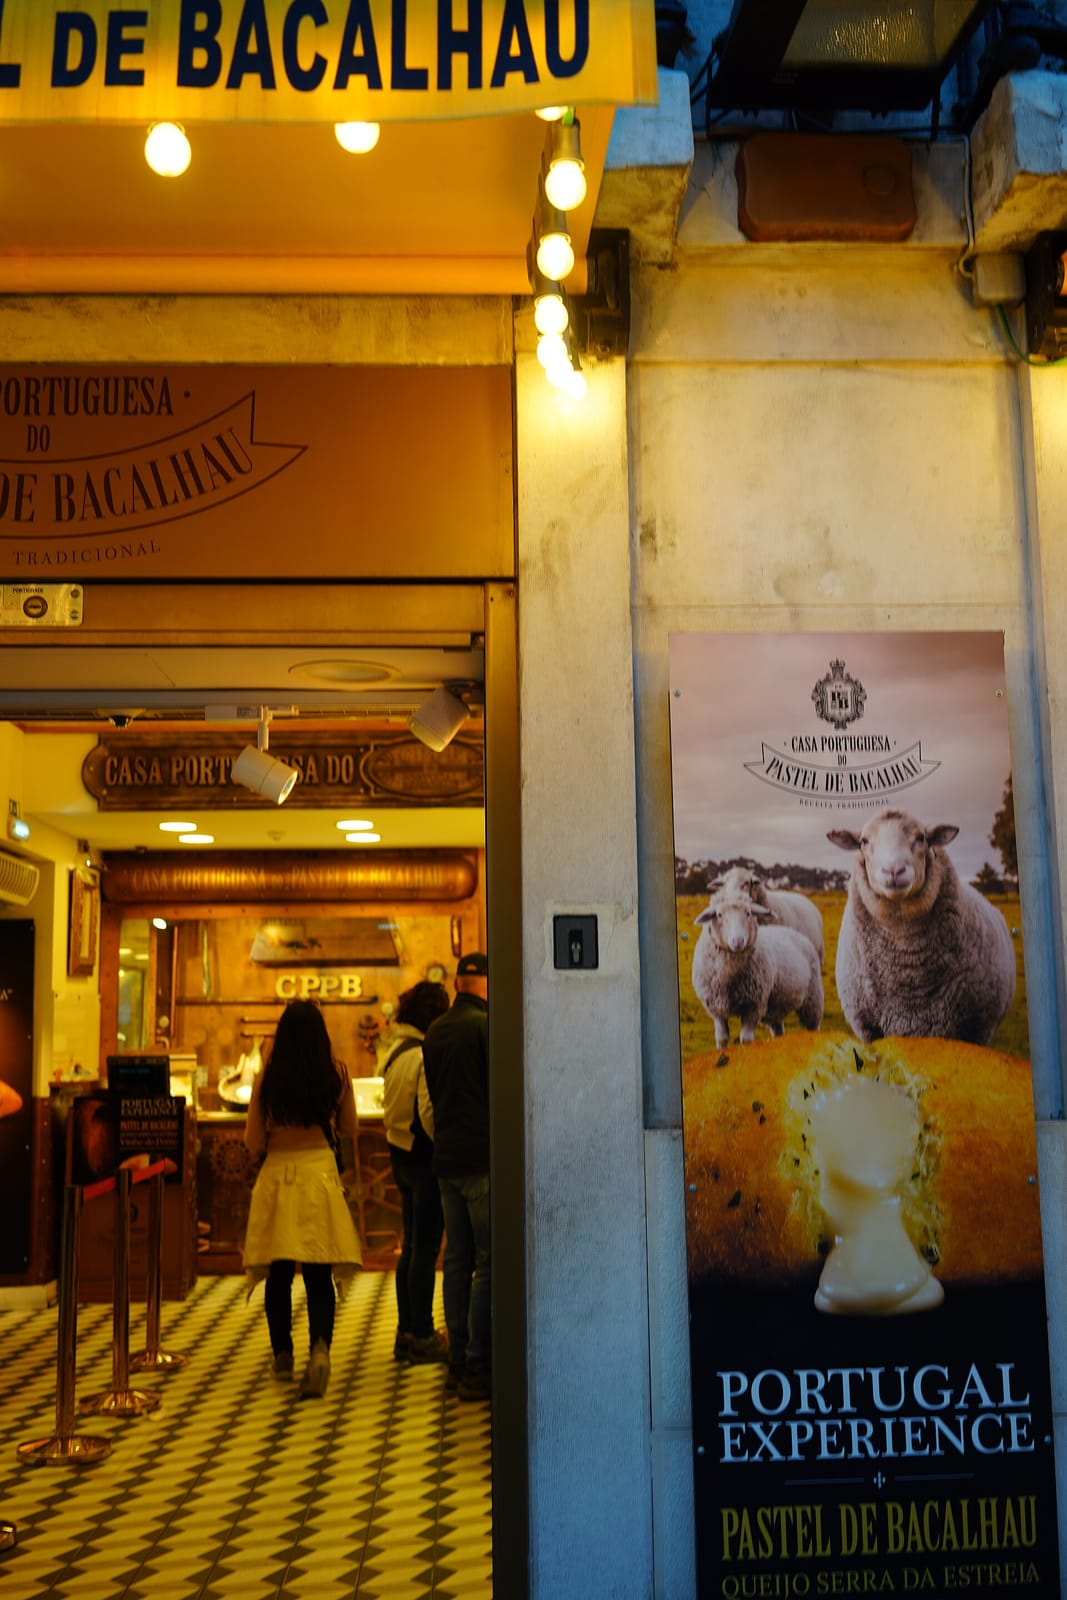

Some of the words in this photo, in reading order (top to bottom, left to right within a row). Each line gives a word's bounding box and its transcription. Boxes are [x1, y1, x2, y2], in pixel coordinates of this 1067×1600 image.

[51, 11, 148, 88] DE
[176, 0, 590, 92] BACALHAU
[0, 375, 174, 417] ORTUGUESA
[26, 424, 51, 453] DO
[52, 427, 253, 523] BACALHAU
[12, 539, 161, 566] TRADICIONAL
[791, 735, 818, 752] CASA
[820, 735, 891, 753] PORTUGUESA
[837, 754, 847, 766] DO
[104, 756, 163, 787] CASA
[170, 754, 319, 786] PORTSA
[326, 753, 355, 785] DO
[765, 757, 819, 792] PASTEL
[825, 772, 844, 793] DE
[849, 755, 922, 793] BACALHAU
[275, 974, 362, 999] CPPB
[716, 1362, 1030, 1417] PORTUGAL
[718, 1412, 1035, 1463] EXPERIENCE
[720, 1504, 831, 1561] PASTEL
[839, 1501, 878, 1557] DE
[886, 1496, 1037, 1553] BACALHAU
[721, 1572, 810, 1600] QUEIJO
[817, 1567, 895, 1594] SERRA
[904, 1566, 936, 1590] DA
